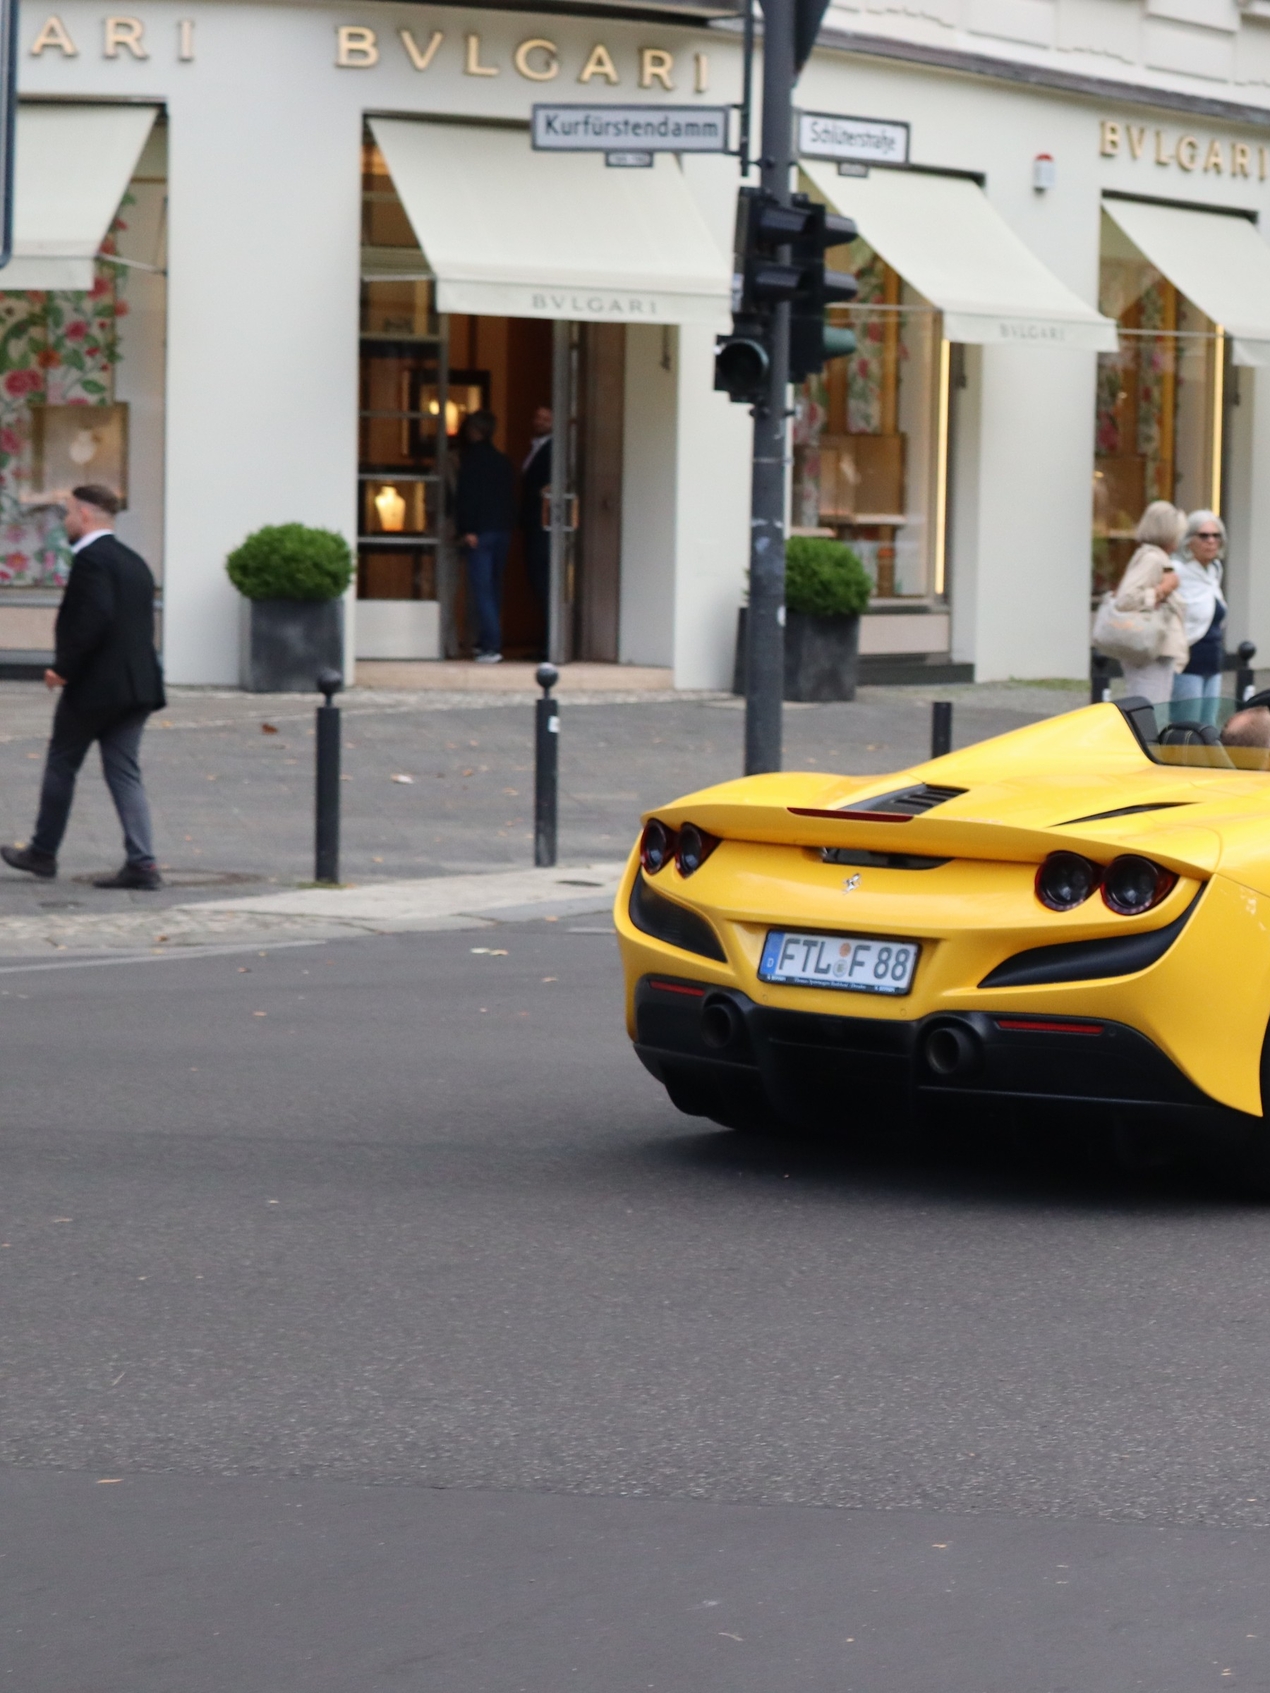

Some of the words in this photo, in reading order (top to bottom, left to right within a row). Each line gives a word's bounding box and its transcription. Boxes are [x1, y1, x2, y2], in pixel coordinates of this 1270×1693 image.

[336, 25, 709, 93] BVLGARI
[544, 114, 718, 138] Kurfürstendamm
[1099, 120, 1269, 182] BVLGARI
[532, 293, 657, 315] BVLGARI
[1000, 323, 1065, 341] BVLGARI
[766, 958, 774, 968] D
[778, 938, 832, 974] FTL
[848, 944, 871, 977] F
[873, 947, 911, 981] 88
